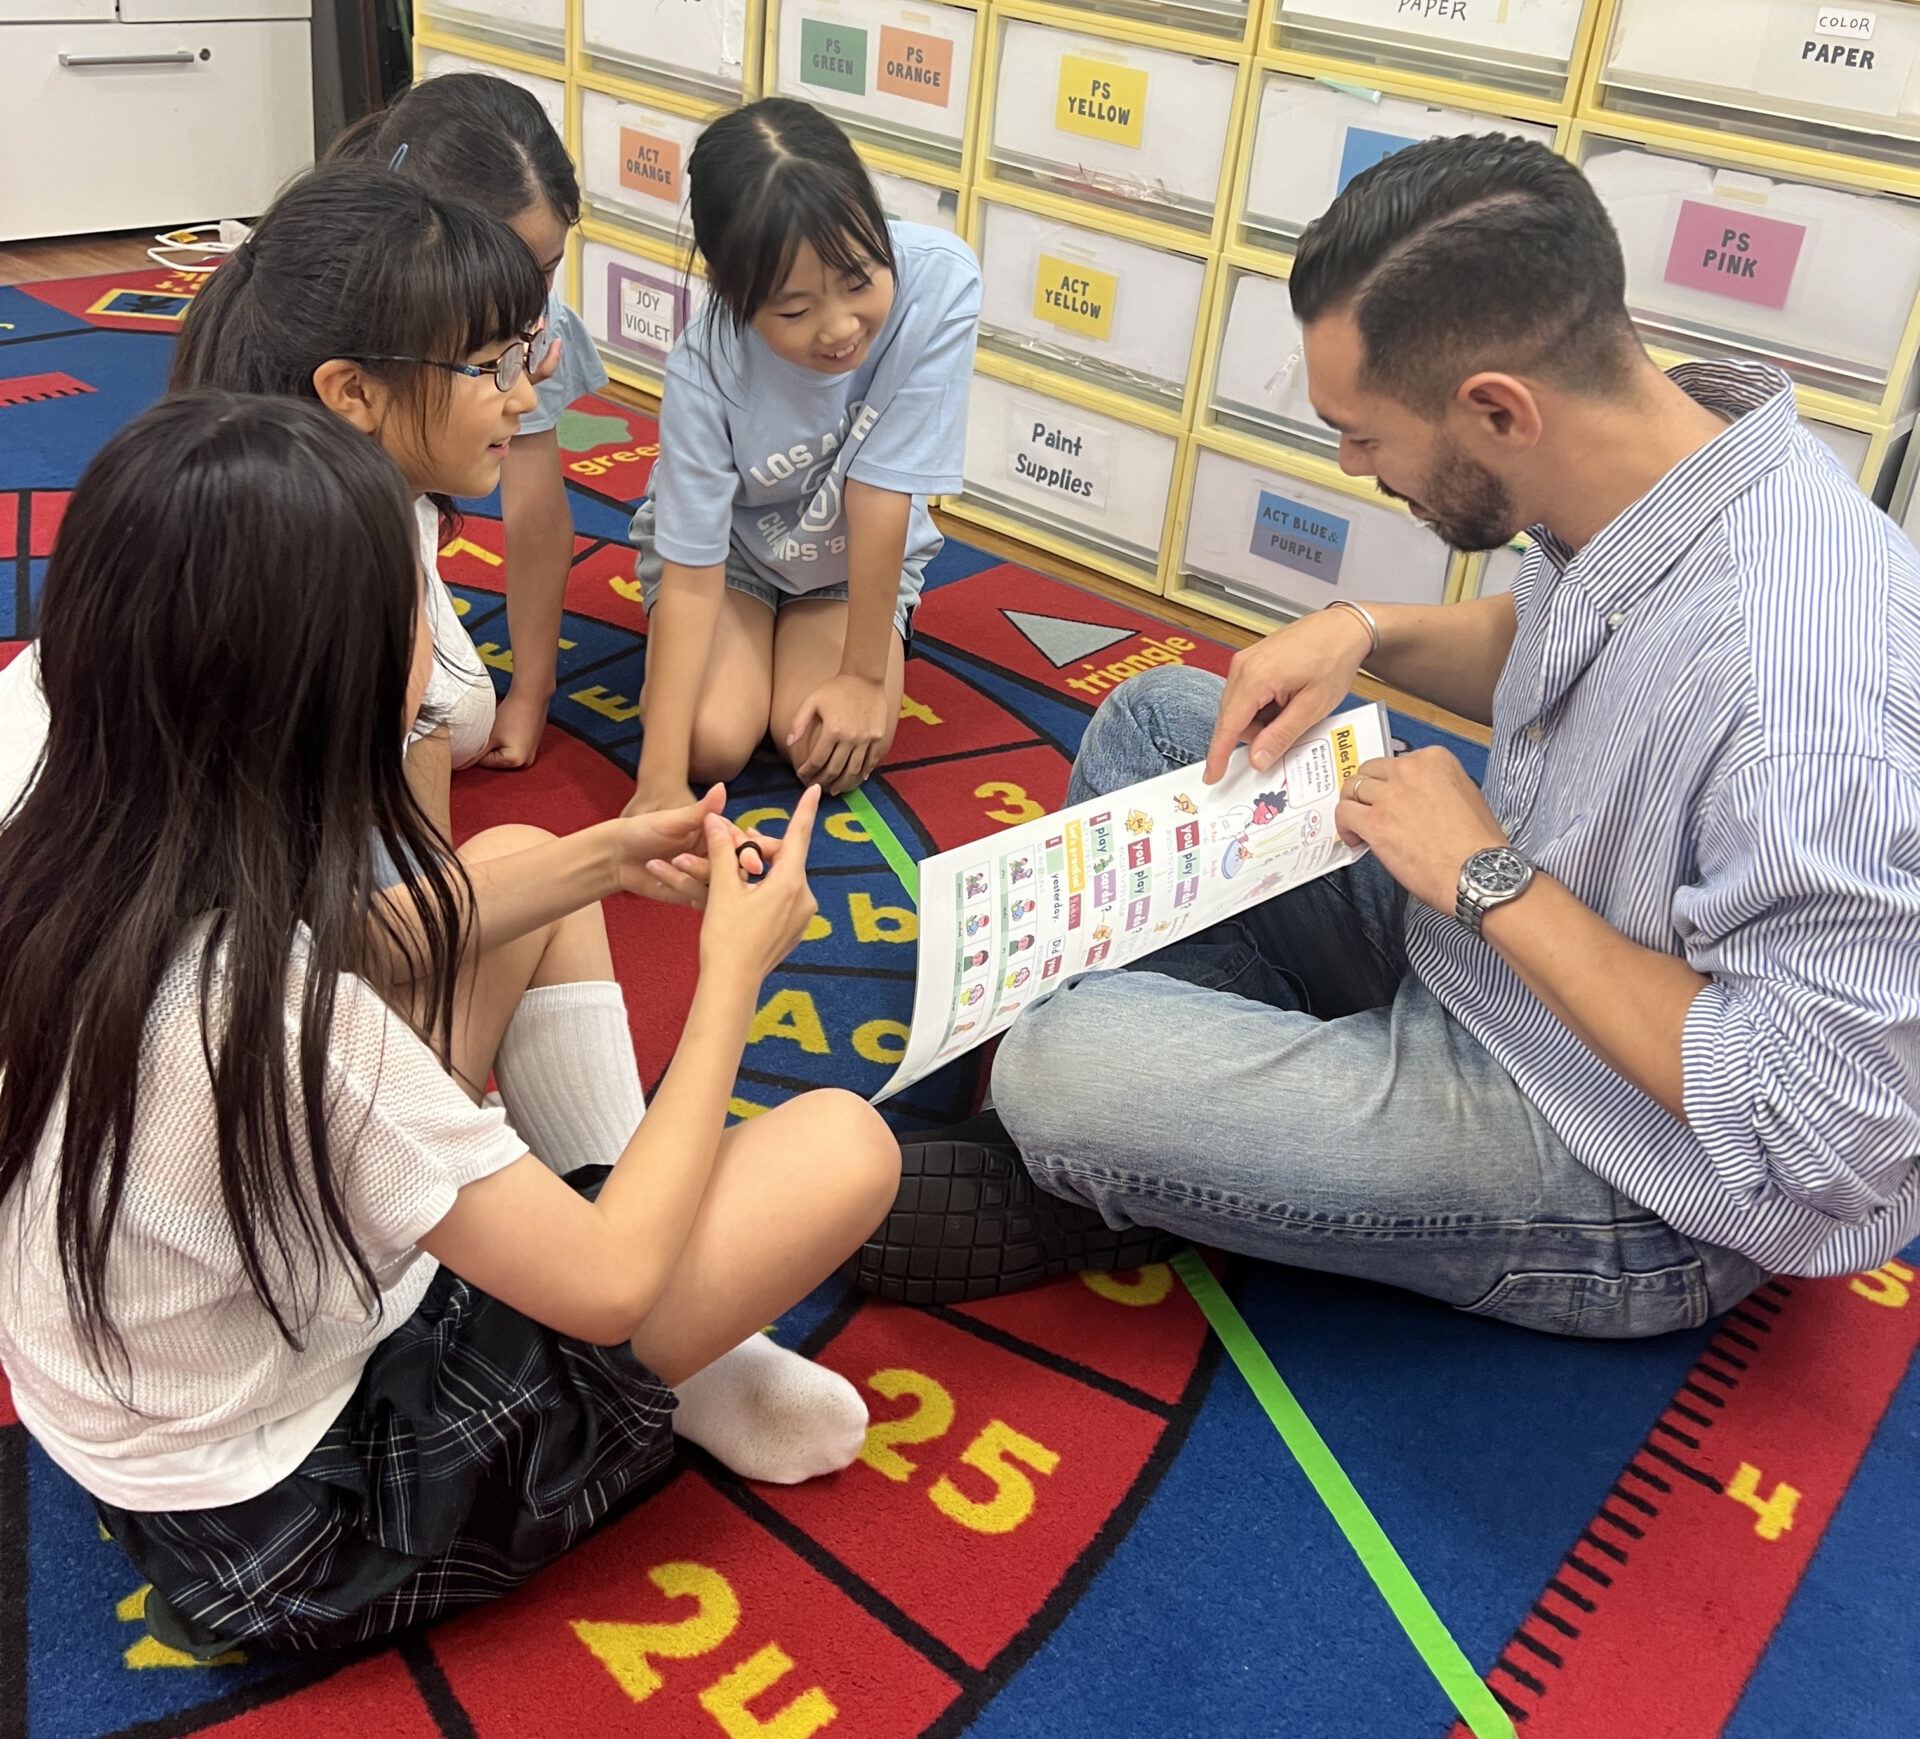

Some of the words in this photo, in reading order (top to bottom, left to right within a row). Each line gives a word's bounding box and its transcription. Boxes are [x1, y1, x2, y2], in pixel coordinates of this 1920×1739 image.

[1398, 0, 1467, 21] PAPER
[1819, 16, 1870, 32] COLOR
[826, 38, 841, 54] PS
[906, 46, 924, 64] PS
[1801, 41, 1875, 70] PAPER
[812, 54, 853, 75] GREEN
[887, 61, 941, 87] ORANGE
[1091, 80, 1111, 100] PS
[1067, 96, 1130, 126] YELLOW
[638, 146, 660, 164] ACT
[626, 159, 672, 185] ORANGE
[1721, 228, 1751, 252] PS
[1702, 248, 1758, 278] PINK
[1061, 276, 1090, 297] ACT
[636, 290, 660, 311] JOY
[1044, 288, 1101, 319] YELLOW
[625, 314, 671, 343] VIOLET
[1032, 423, 1083, 456] Paint
[569, 443, 660, 475] gree
[750, 444, 814, 487] LOS
[1015, 453, 1093, 497] Supplies
[1262, 506, 1290, 525] ACT
[1271, 534, 1323, 564] PURPLE
[1065, 637, 1196, 695] triangle
[1337, 730, 1353, 763] Rules
[974, 782, 1045, 824] 3
[1095, 827, 1110, 853] play
[1180, 825, 1194, 849] you
[1132, 842, 1146, 867] you
[1183, 853, 1197, 875] play
[1134, 871, 1149, 894] play
[1051, 873, 1063, 923] yesterday.
[1052, 939, 1062, 954] Did
[1092, 944, 1105, 964] you
[859, 1368, 1060, 1534] 25
[1727, 1462, 1802, 1540] 4
